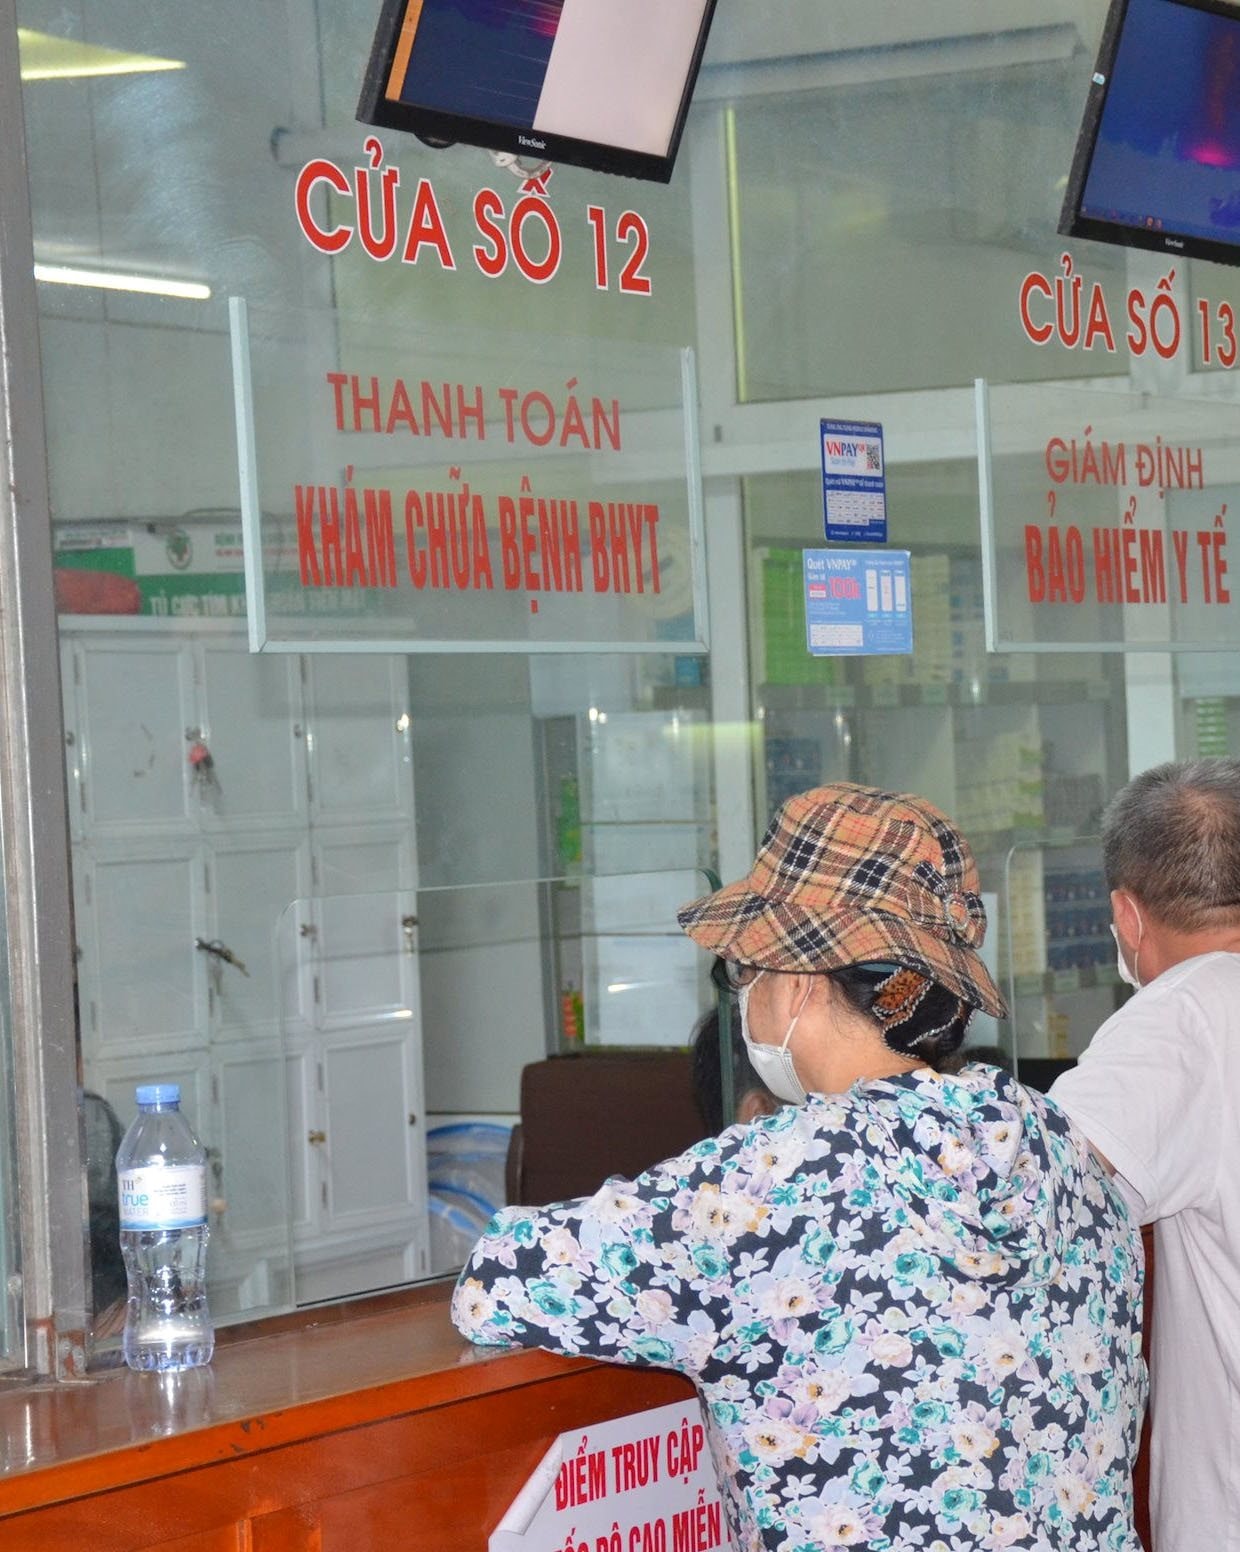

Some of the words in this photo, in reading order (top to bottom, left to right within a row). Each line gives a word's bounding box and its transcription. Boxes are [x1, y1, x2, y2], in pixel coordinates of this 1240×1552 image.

[295, 135, 456, 270] CỬA
[473, 163, 562, 284] SỐ
[587, 204, 652, 296] 12
[1019, 252, 1117, 352] CỬA
[1127, 265, 1182, 361] SỐ
[1197, 297, 1238, 369] 13
[327, 373, 485, 440] THANH
[499, 377, 621, 451] TOÁN
[1045, 425, 1127, 486] GIÁM
[1135, 435, 1204, 499] ĐỊNH
[295, 465, 397, 588] KHÁM
[404, 465, 494, 591] CHỮA
[498, 475, 583, 613] BỆNH
[588, 501, 661, 594] BHYT
[1024, 490, 1086, 604] BẢO
[1092, 495, 1167, 604] HIỂM
[1172, 530, 1188, 604] Y
[1197, 503, 1230, 604] TẾ
[554, 1435, 606, 1511] ĐIỂM
[612, 1435, 660, 1493] TRUY
[666, 1417, 704, 1484] CẬP
[672, 1488, 721, 1552] MIỄN
